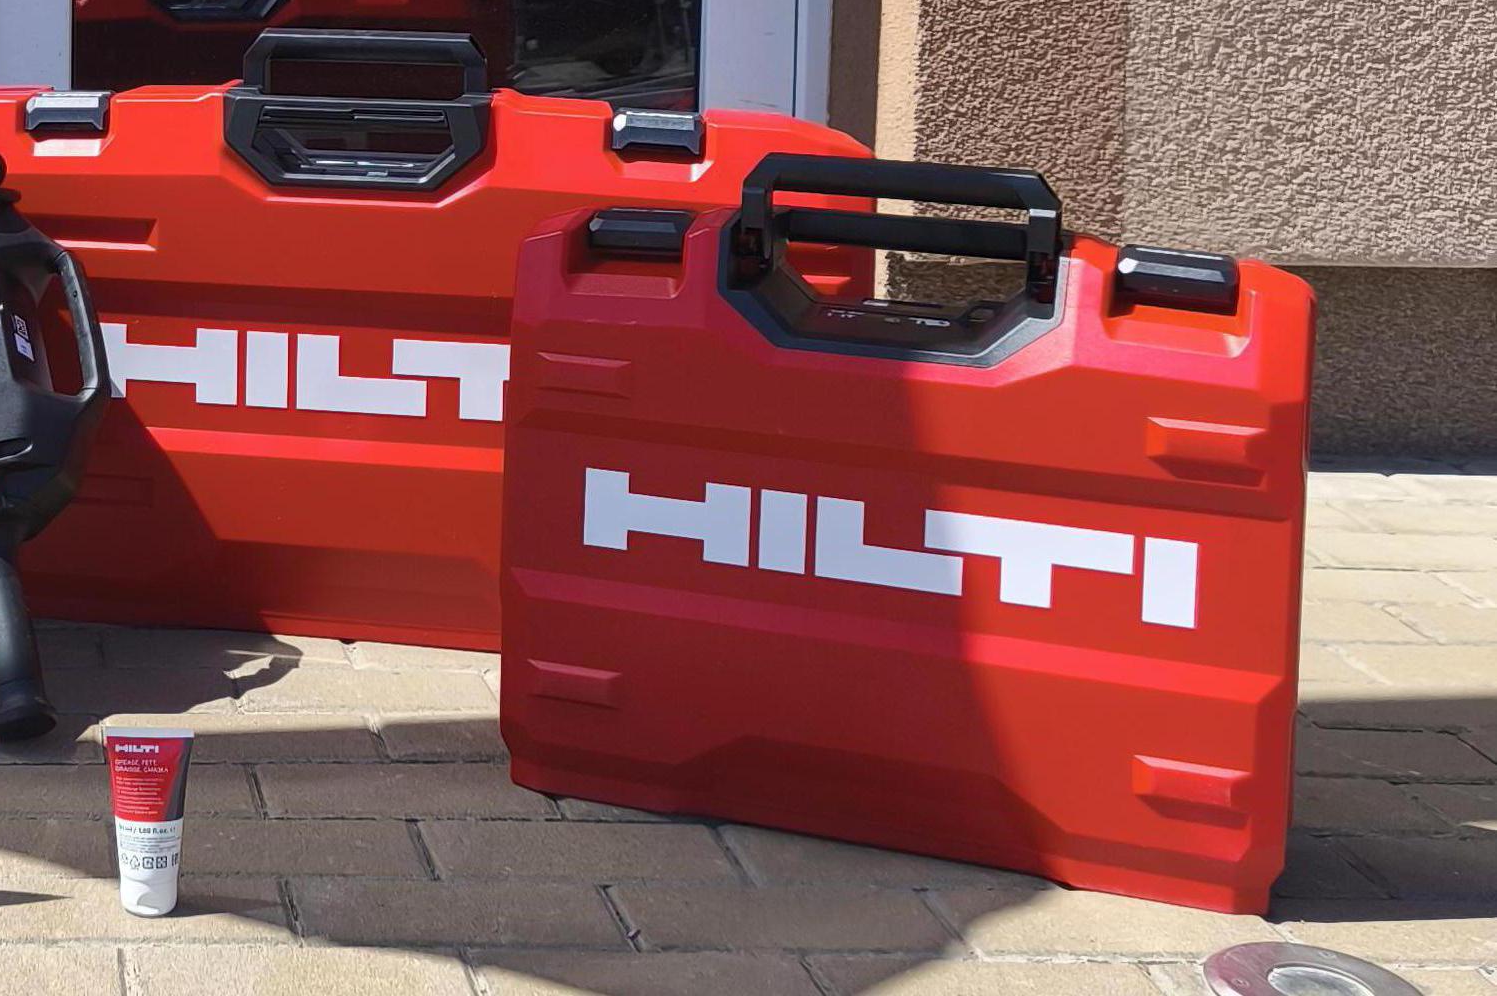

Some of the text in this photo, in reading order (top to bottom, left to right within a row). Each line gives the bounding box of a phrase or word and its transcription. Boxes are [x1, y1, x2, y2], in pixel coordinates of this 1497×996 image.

[100, 322, 510, 422] HILT
[583, 467, 1199, 629] HILTI
[115, 744, 160, 753] HILTI
